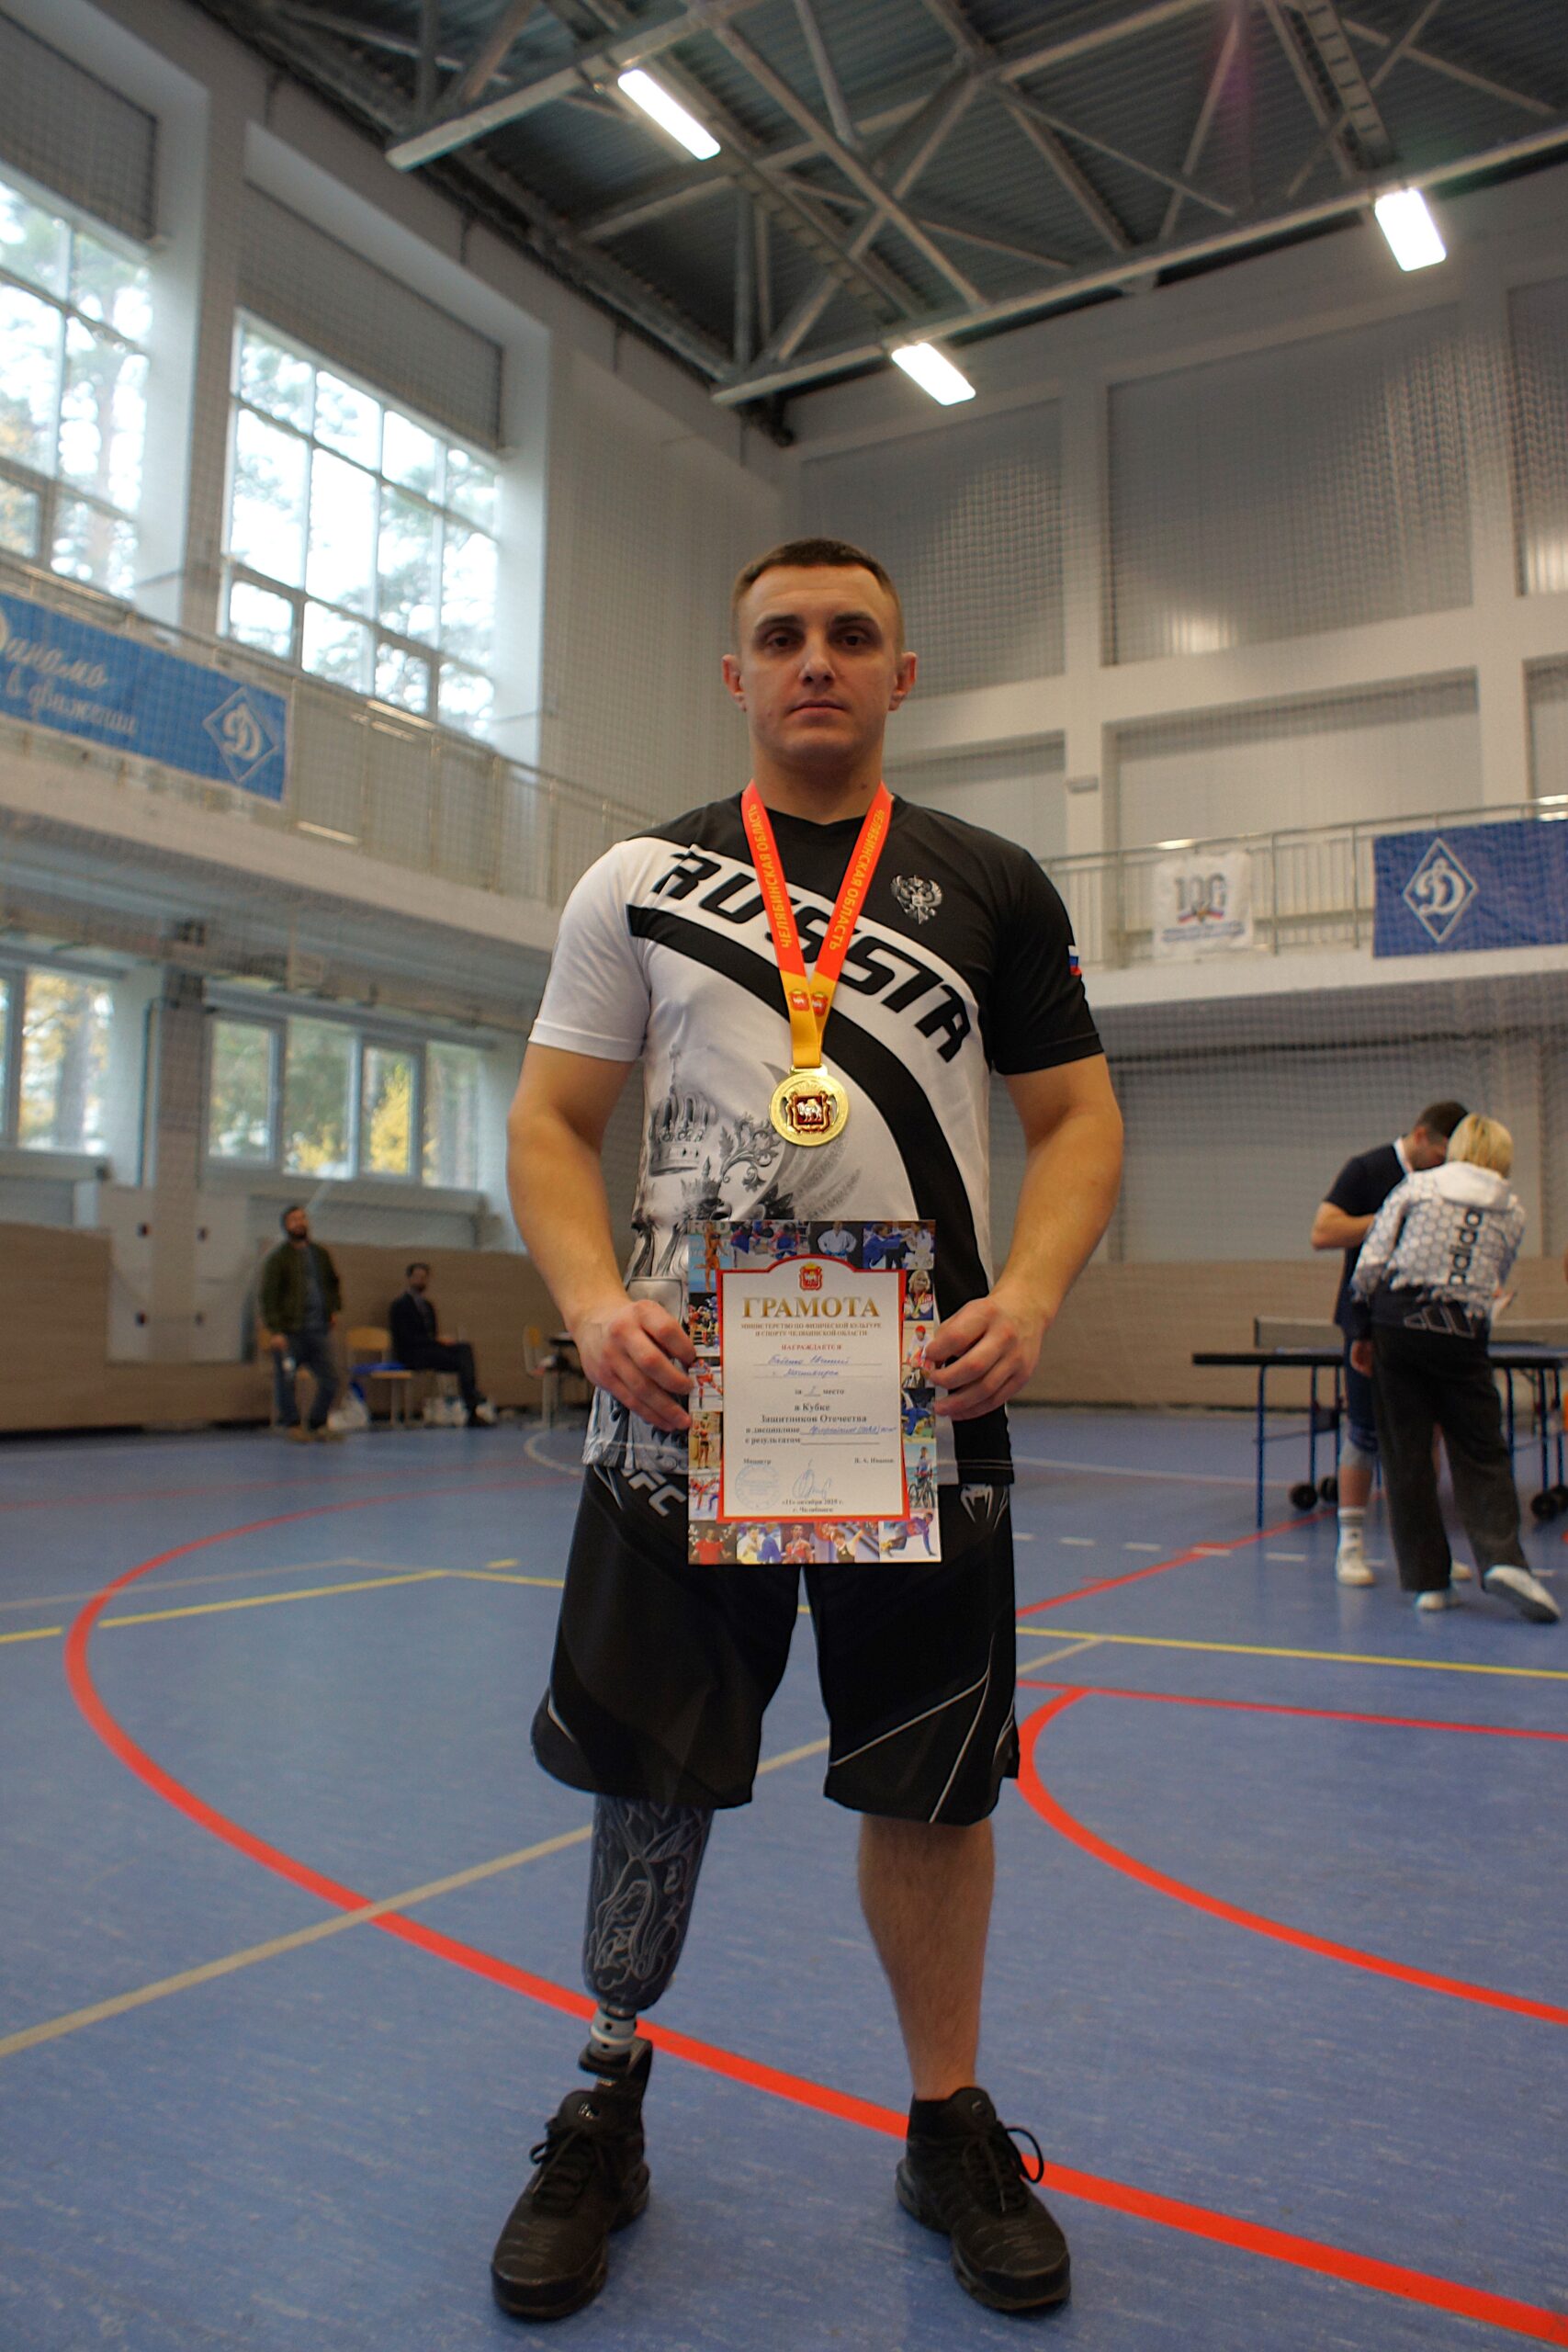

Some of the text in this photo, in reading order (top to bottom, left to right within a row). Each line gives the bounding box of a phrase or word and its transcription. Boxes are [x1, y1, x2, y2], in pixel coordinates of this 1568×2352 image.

[0, 608, 108, 690] инамо
[749, 803, 793, 948] ЧЕЛЯБИНСКАЯ ОБЛАСТЬ
[829, 808, 885, 950] ЧЕЛЯБИНСКАЯ ОБЛАСТЬ
[651, 851, 971, 1063] RUSSIA
[1450, 1205, 1484, 1286] adida
[742, 1296, 880, 1318] ГРАМОТА
[750, 1437, 801, 1445] результатом
[761, 1413, 867, 1423] Защитников Отечества
[803, 1402, 830, 1413] Кубке
